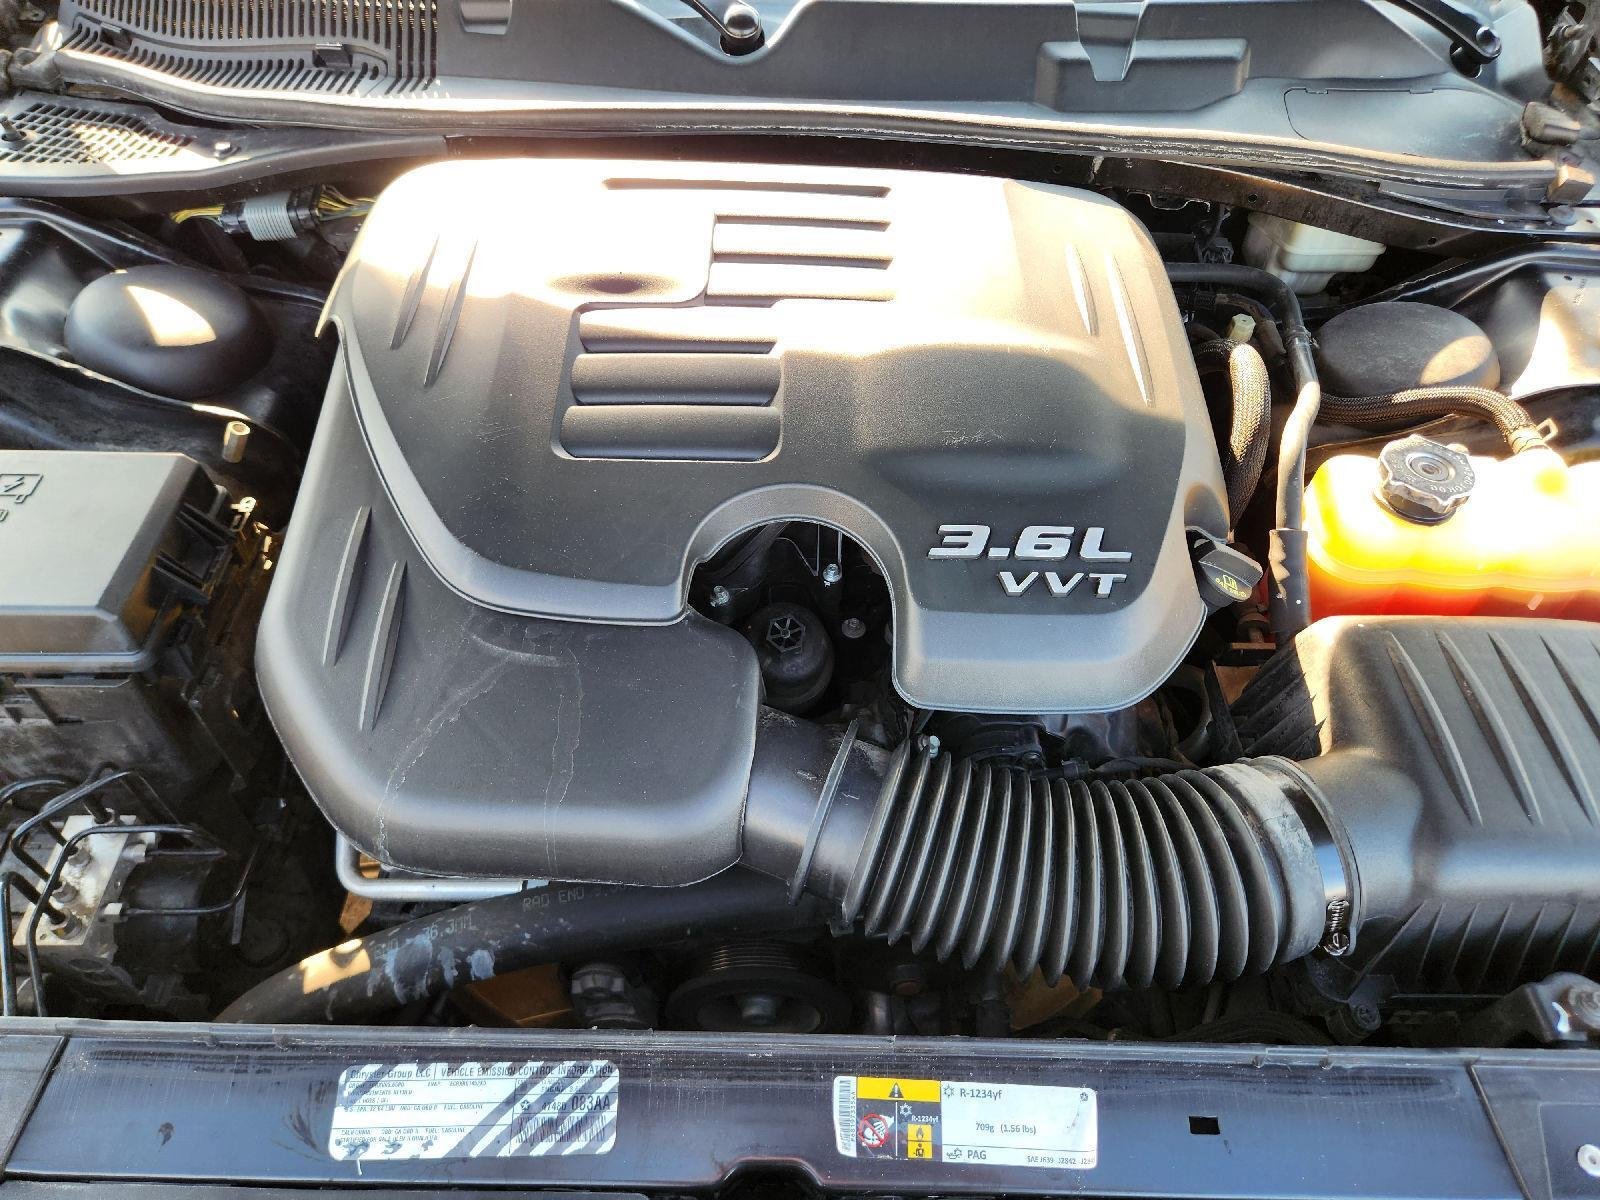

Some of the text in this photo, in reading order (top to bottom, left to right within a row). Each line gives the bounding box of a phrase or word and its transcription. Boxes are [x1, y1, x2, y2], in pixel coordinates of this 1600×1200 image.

[927, 524, 1133, 563] 3.6L
[998, 571, 1128, 599] VVT
[350, 1063, 614, 1081] Chrysler Group LLC VEHICLE EMISSION CONTROL INFORMATION
[959, 1088, 1003, 1102] R-1234yf
[911, 1114, 939, 1124] R-1234yf
[975, 1122, 1037, 1136] 709g (1.56 lbs)
[966, 1149, 988, 1161] PAG
